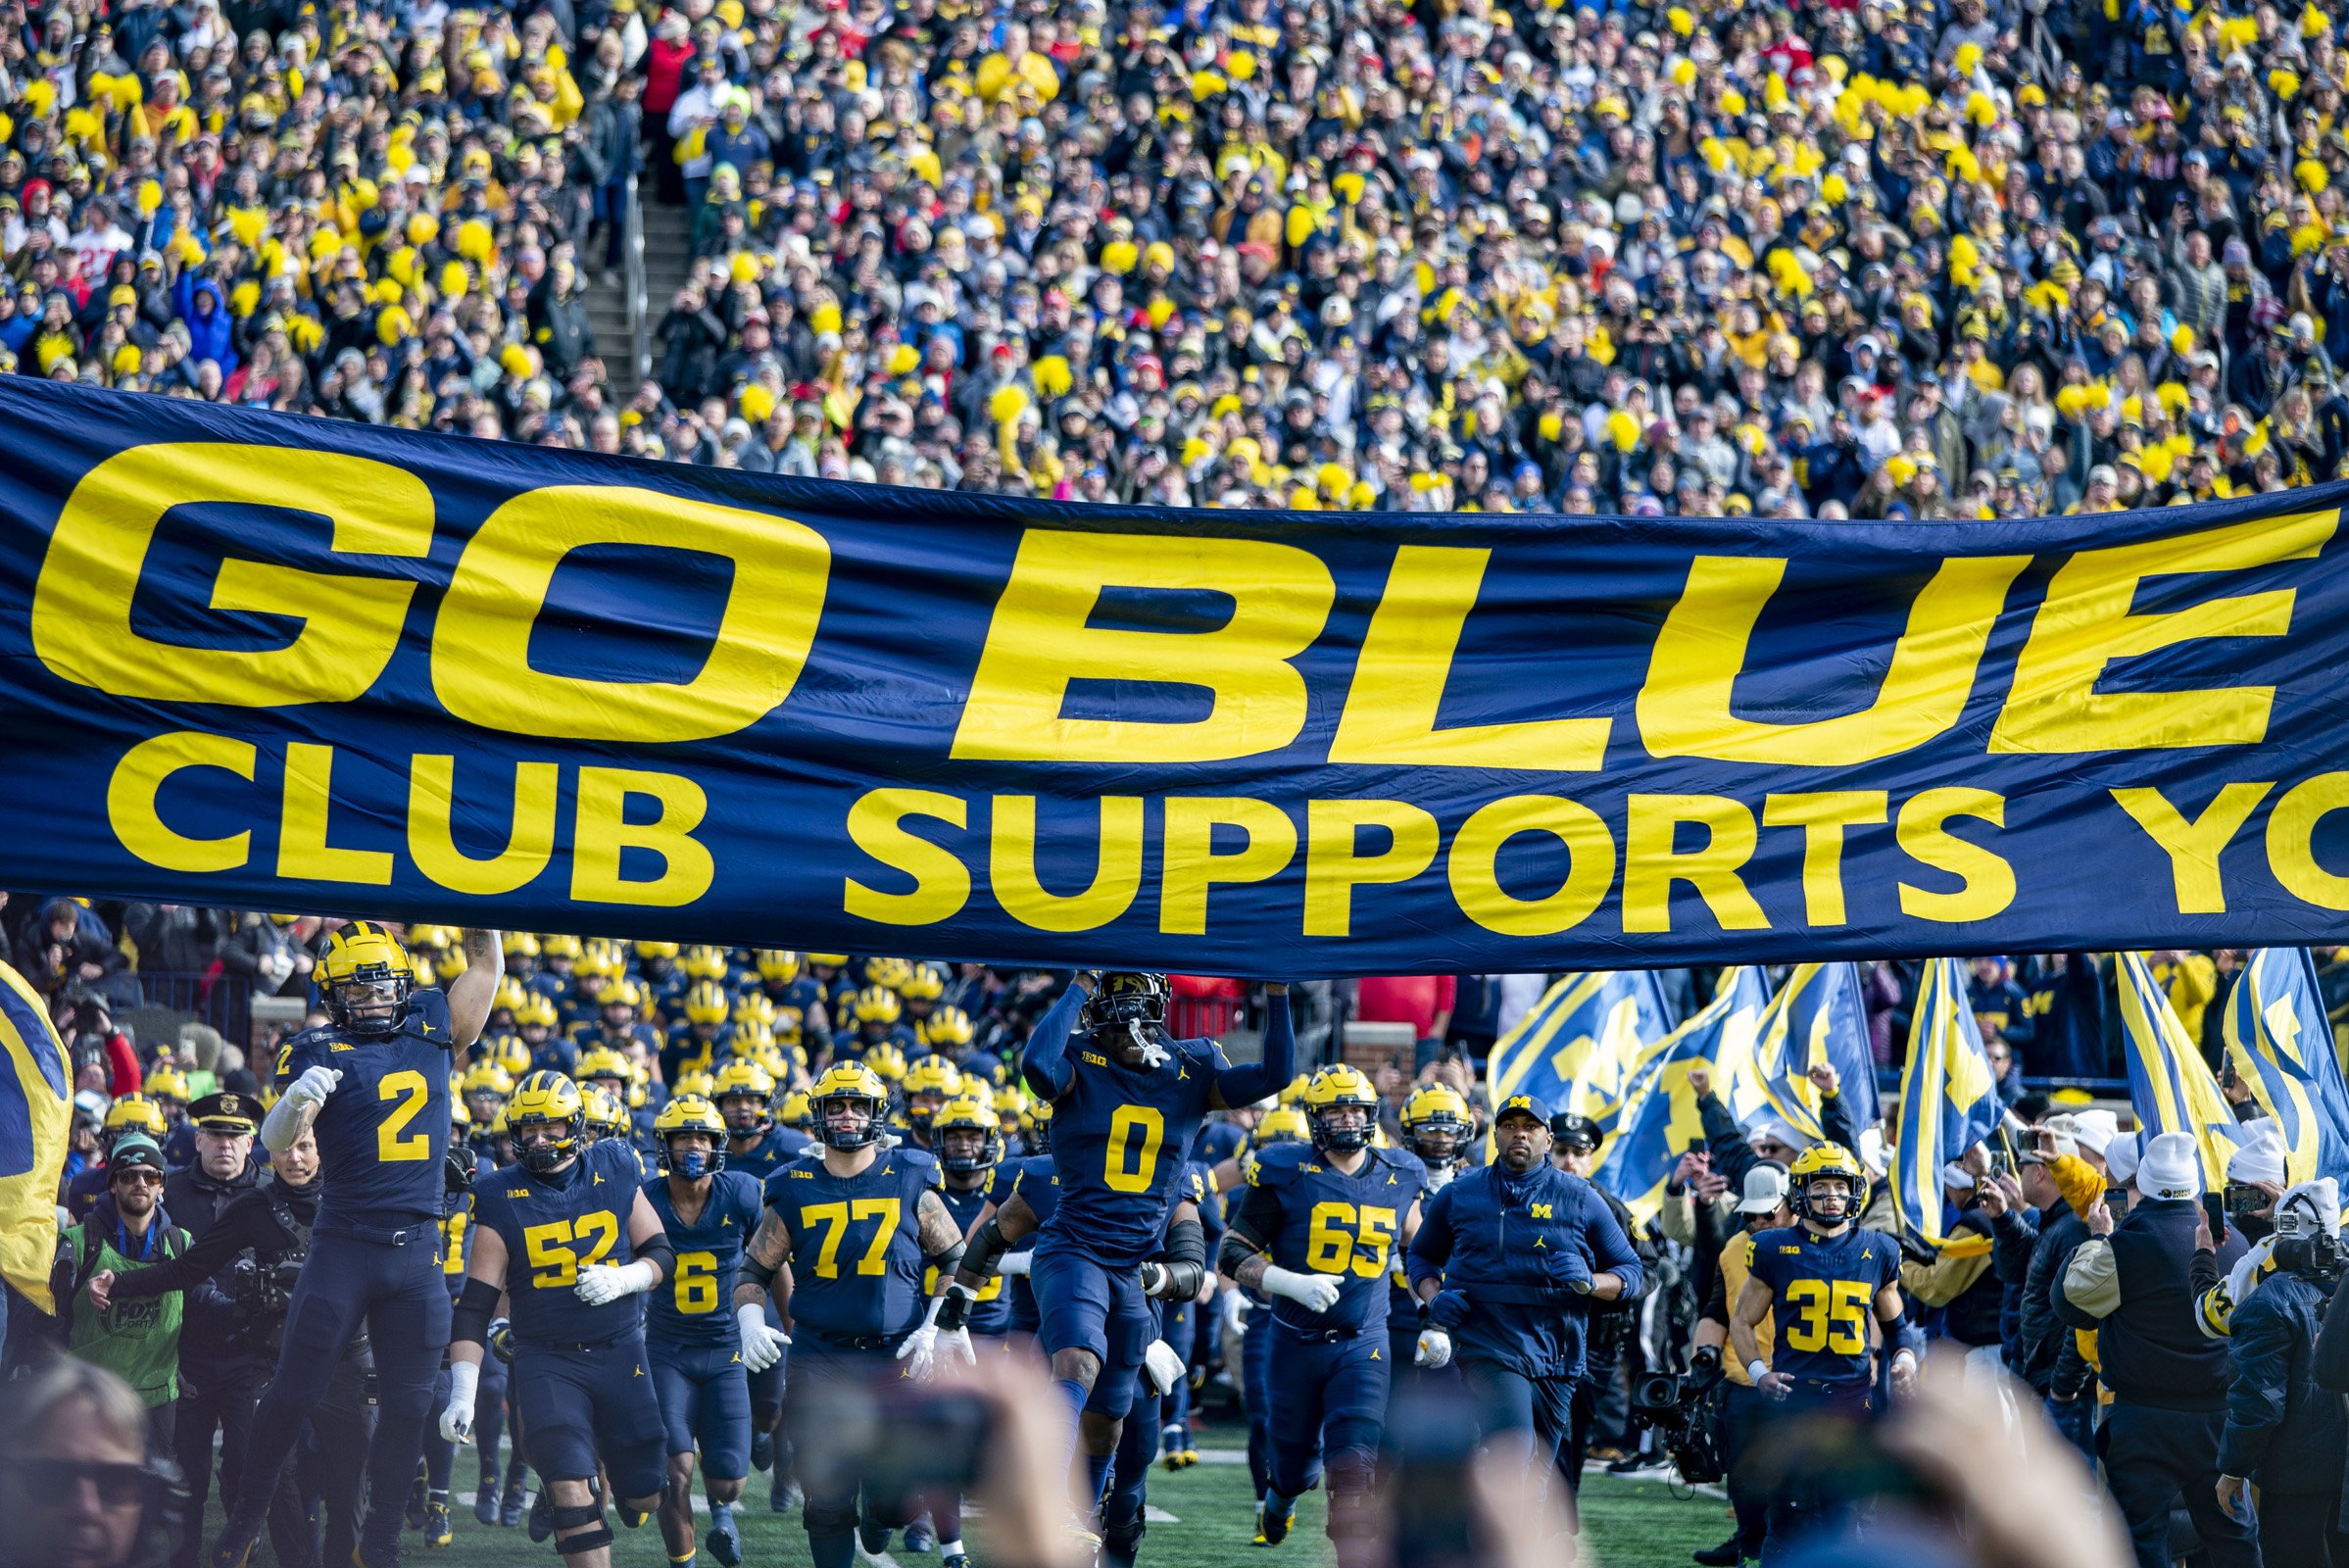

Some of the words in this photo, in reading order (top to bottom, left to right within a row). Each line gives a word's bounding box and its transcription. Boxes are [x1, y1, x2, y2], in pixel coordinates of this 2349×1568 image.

[31, 442, 831, 743] GO
[950, 509, 2339, 769] BLUE
[108, 731, 713, 906] CLUB
[844, 788, 2015, 936] SUPPORTS
[275, 1044, 294, 1075] 2
[377, 1069, 430, 1162] 2
[1509, 1096, 1531, 1108] M
[1103, 1103, 1164, 1194] 0
[523, 1209, 619, 1289] 52
[801, 1198, 901, 1279] 77
[1306, 1201, 1397, 1278] 65
[1531, 1203, 1552, 1218] M
[674, 1250, 717, 1314] 6
[1786, 1279, 1873, 1355] 35
